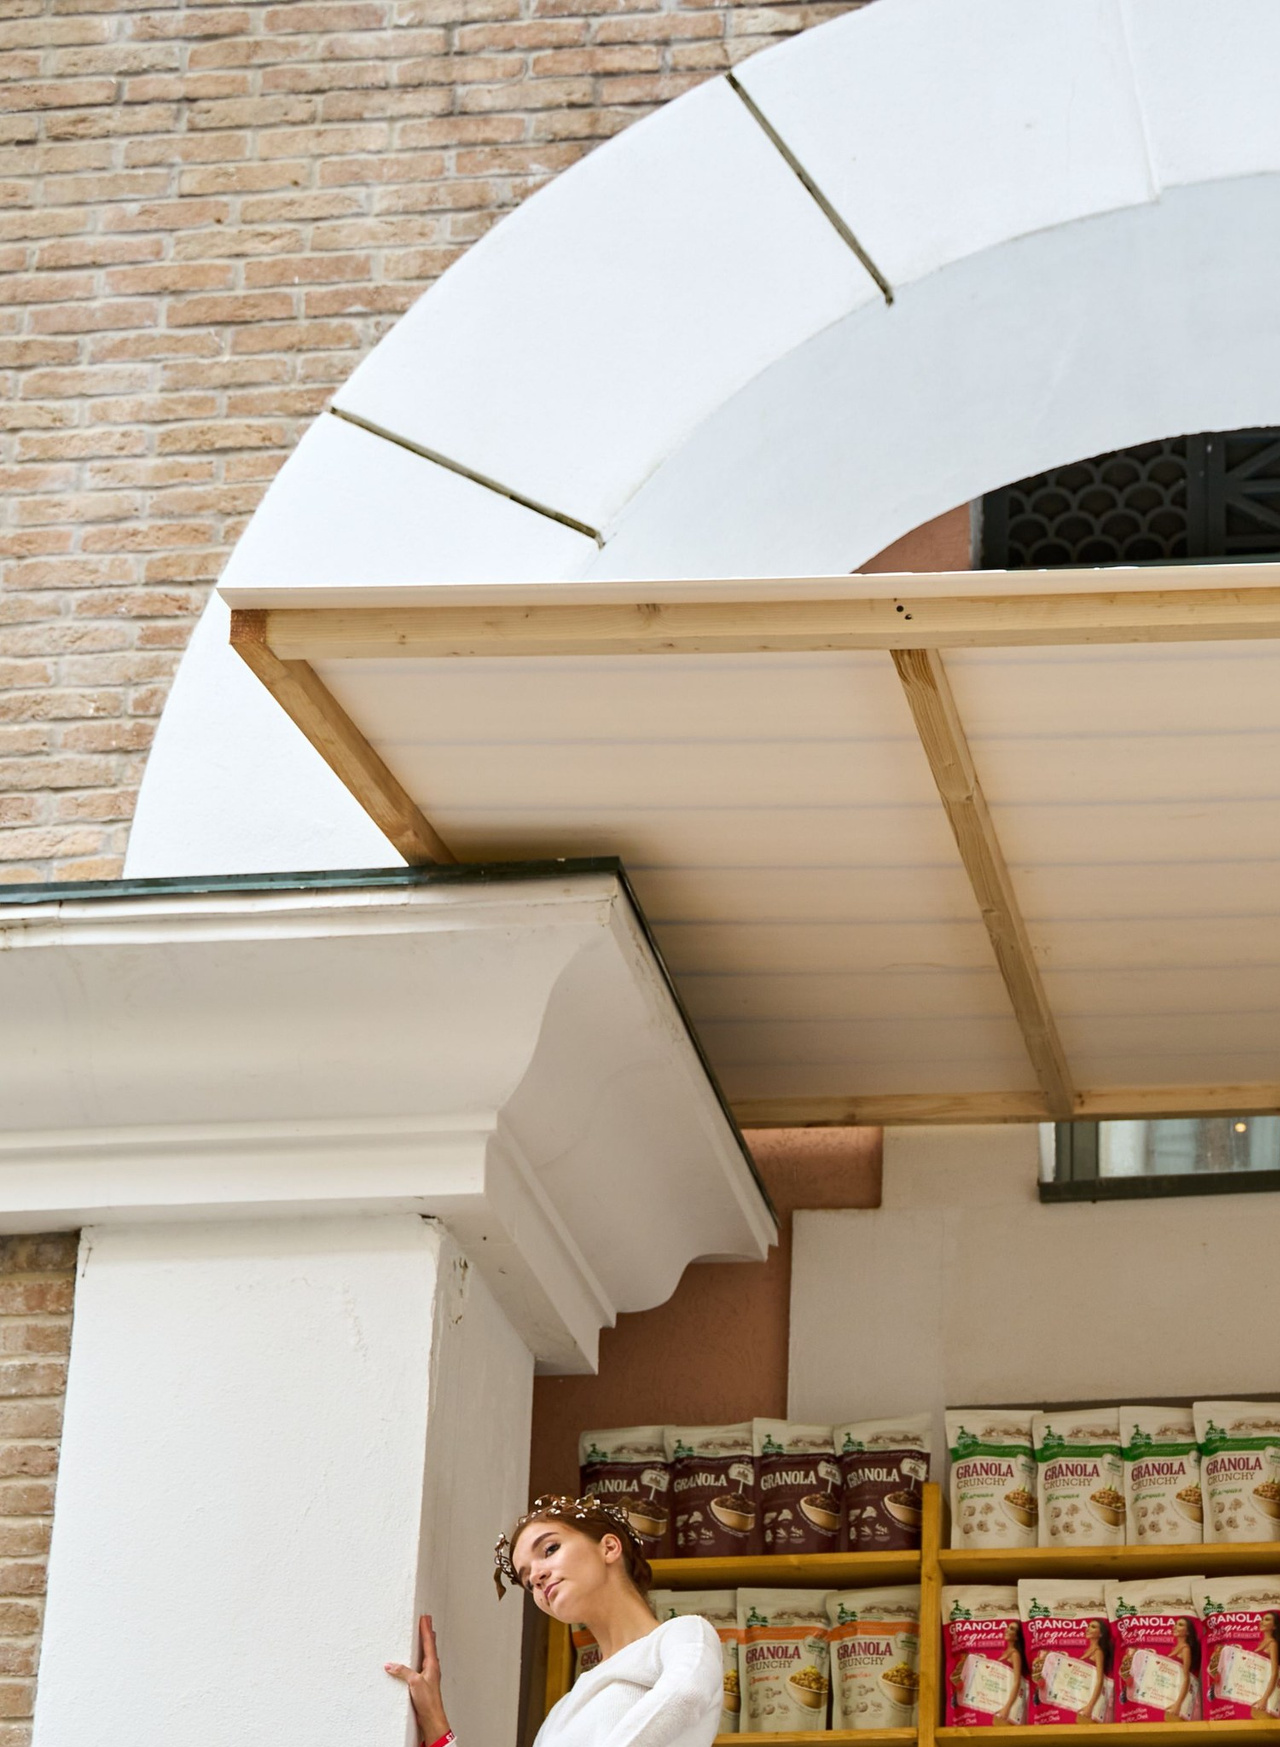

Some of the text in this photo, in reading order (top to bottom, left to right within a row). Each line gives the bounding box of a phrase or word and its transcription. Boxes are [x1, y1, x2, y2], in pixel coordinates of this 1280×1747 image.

[956, 1462, 1014, 1479] GRANOLA
[1044, 1463, 1100, 1481] GRANOLA
[1131, 1461, 1186, 1481] GRANOLA
[1206, 1457, 1262, 1475] GRANOLA
[674, 1474, 727, 1492] GRANOLA
[761, 1471, 816, 1490] GRANOLA
[847, 1468, 899, 1487] GRANOLA
[957, 1478, 1007, 1489] CRUNCHY
[1044, 1478, 1093, 1491] CRUNCHY
[1131, 1476, 1179, 1491] CRUNCHY
[1207, 1472, 1255, 1486] CRUNCHY
[585, 1479, 639, 1496] GRANOLA
[950, 1621, 1008, 1634] GRANOLA
[1028, 1620, 1089, 1632] GRANOLA
[1118, 1617, 1175, 1631] GRANOLA
[1207, 1614, 1262, 1628] GRANOLA
[746, 1646, 801, 1663] GRANOLA
[836, 1641, 893, 1661] GRANOLA
